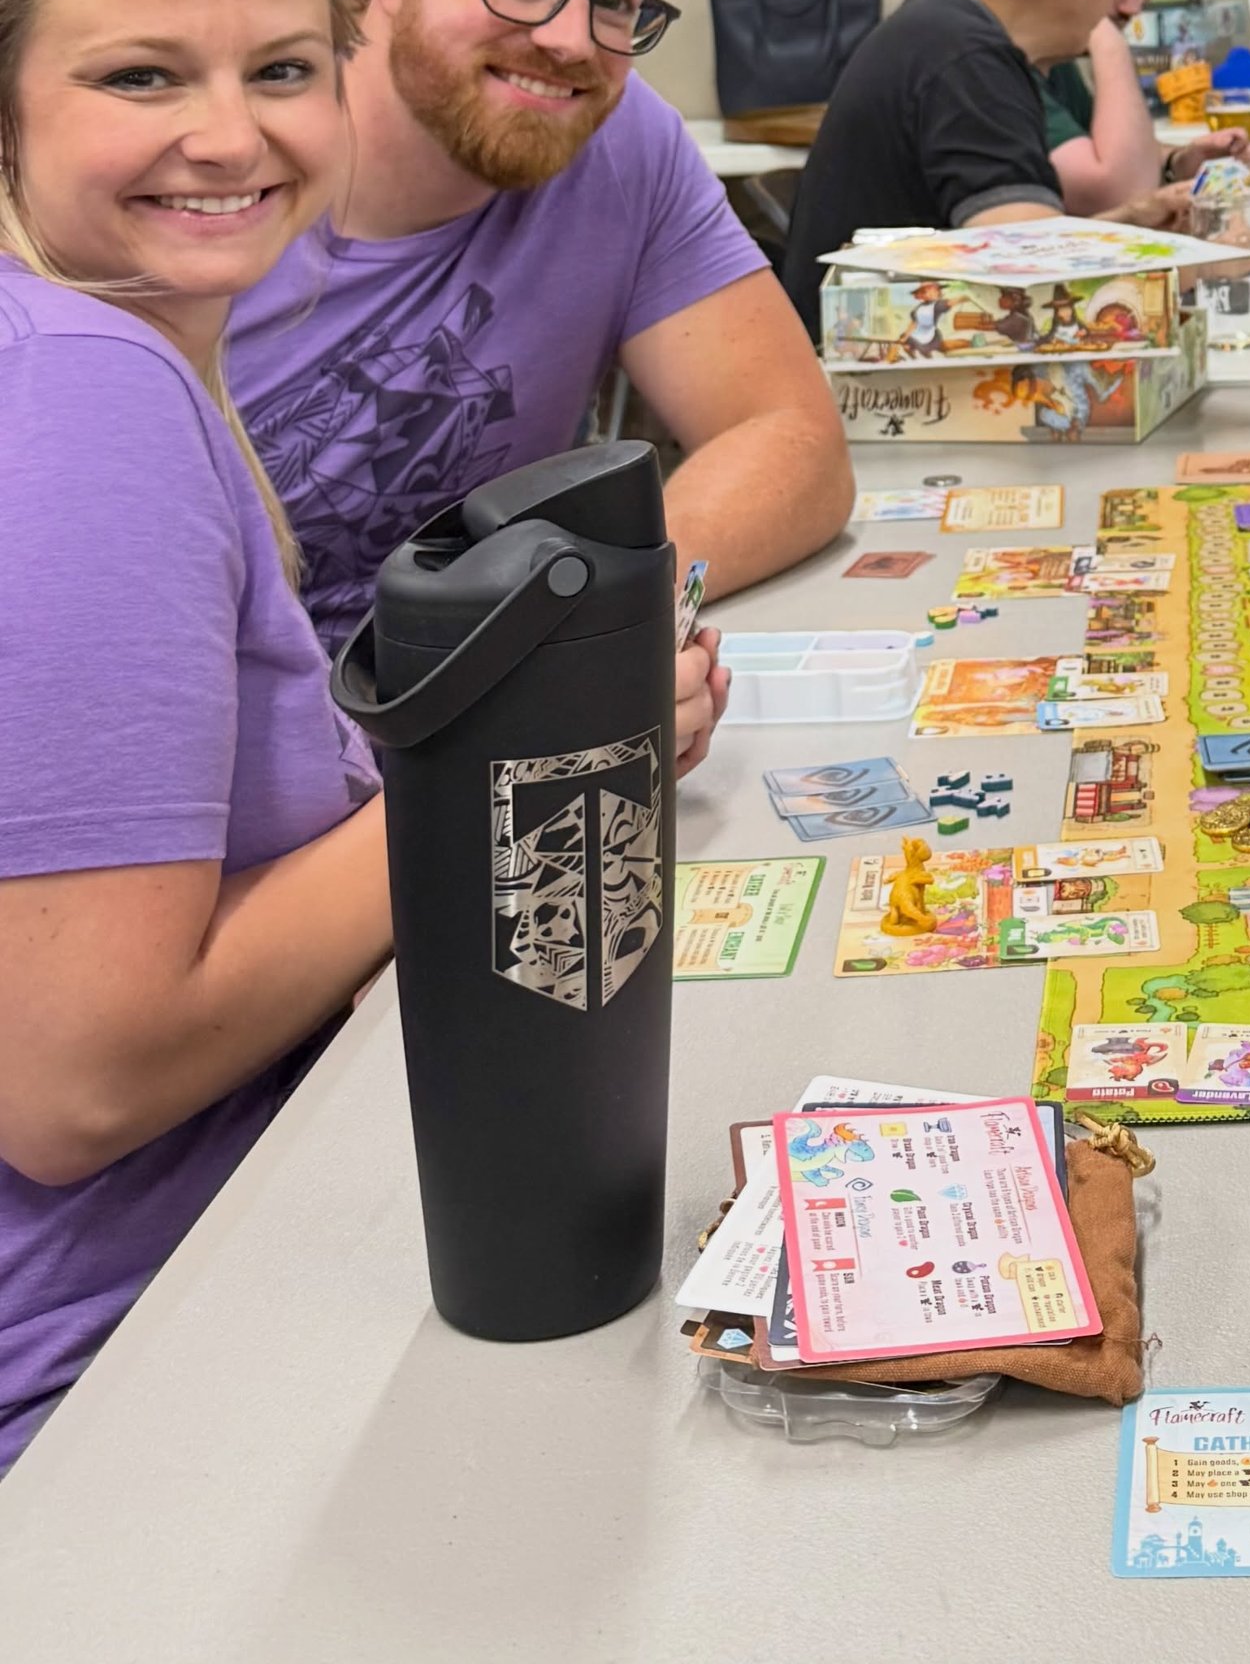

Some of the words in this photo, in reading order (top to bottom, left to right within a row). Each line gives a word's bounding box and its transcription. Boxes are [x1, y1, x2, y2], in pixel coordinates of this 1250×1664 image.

[837, 384, 952, 427] Flamecraft
[1092, 1086, 1136, 1097] Potato
[903, 1152, 918, 1169] Dragon
[947, 1145, 961, 1161] Dragon
[917, 1220, 932, 1238] Dragon
[964, 1221, 980, 1240] Dragon
[932, 1295, 947, 1315] Dragon
[981, 1293, 997, 1314] Dragon
[1149, 1405, 1245, 1426] Flamecraft
[1187, 1458, 1207, 1466] Gain
[1209, 1457, 1239, 1468] goods,
[1187, 1469, 1206, 1478] May
[1207, 1468, 1232, 1478] place
[1171, 1480, 1178, 1488] 3
[1187, 1479, 1206, 1489] May
[1170, 1491, 1178, 1499] 4
[1186, 1491, 1205, 1500] May
[1226, 1490, 1248, 1499] shop
